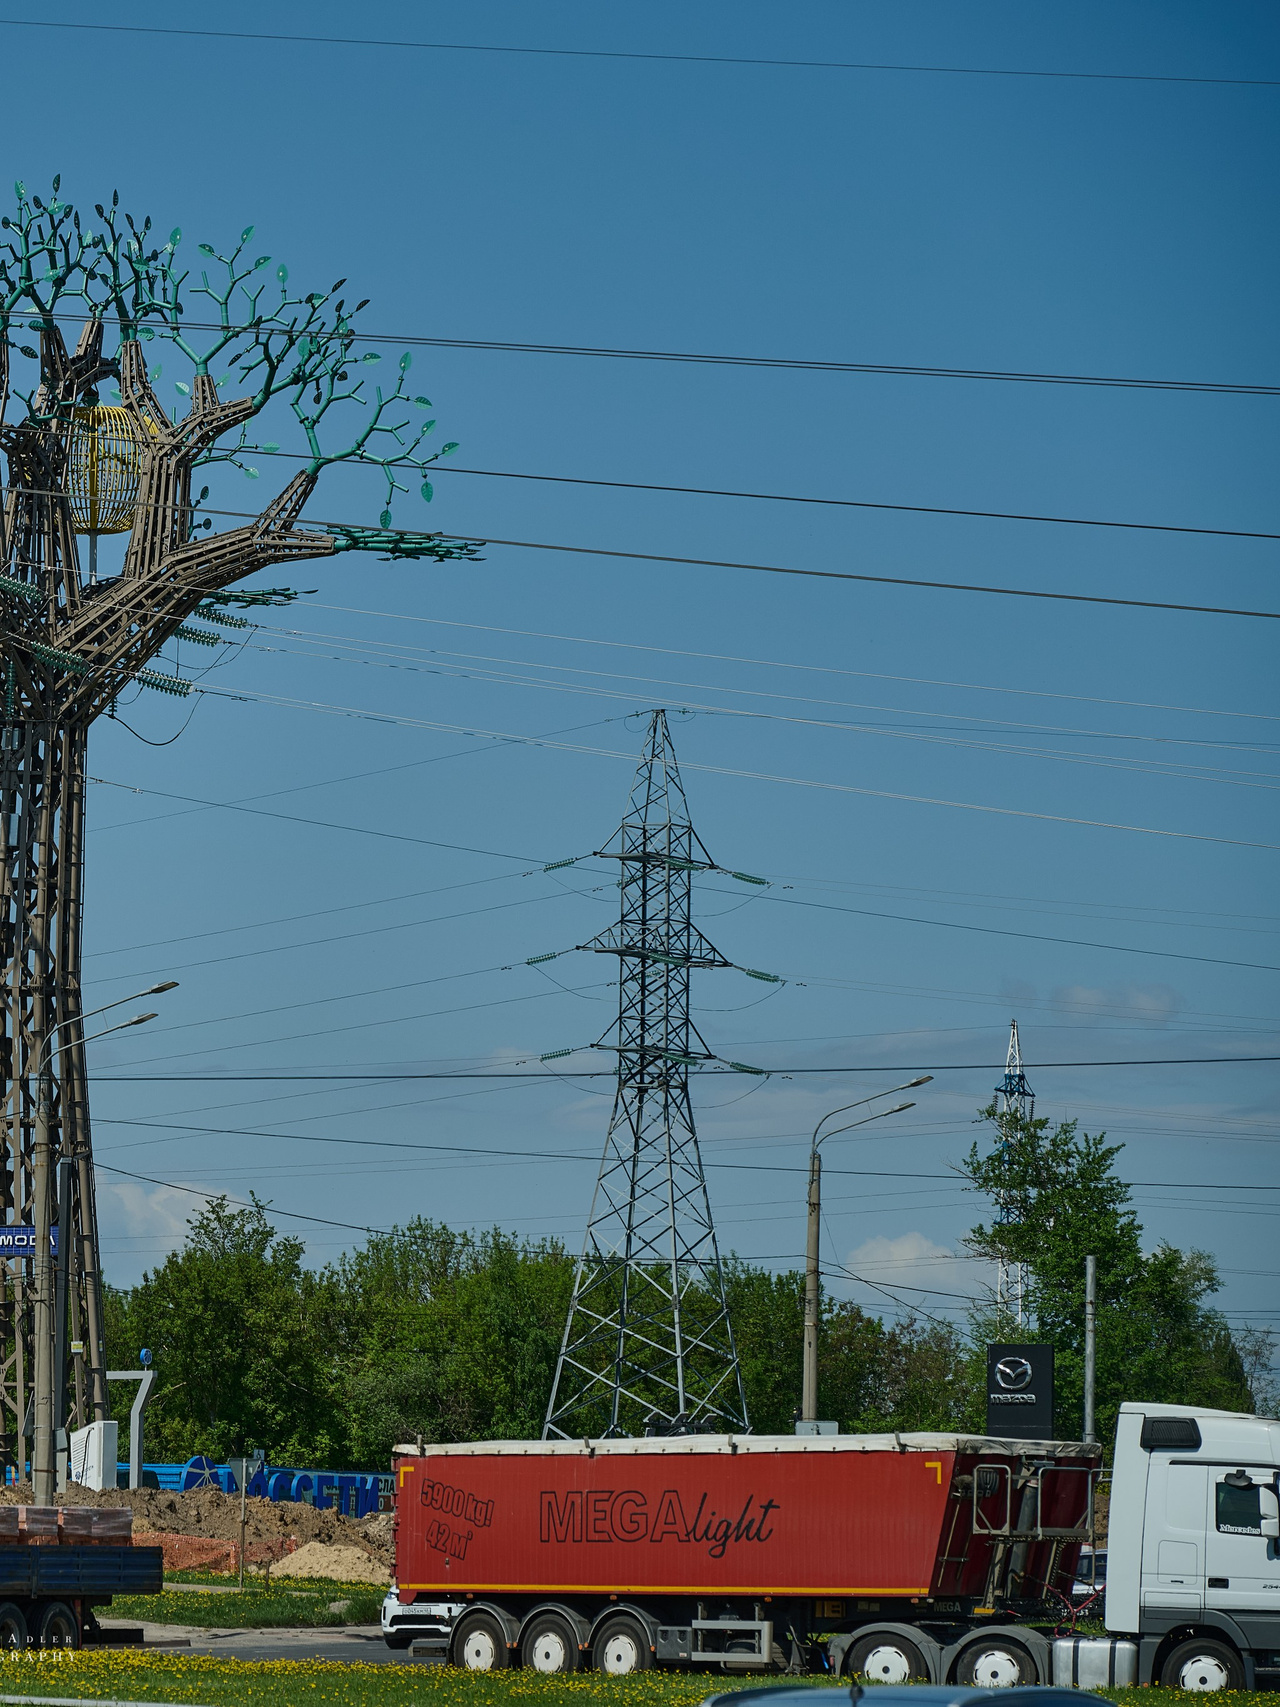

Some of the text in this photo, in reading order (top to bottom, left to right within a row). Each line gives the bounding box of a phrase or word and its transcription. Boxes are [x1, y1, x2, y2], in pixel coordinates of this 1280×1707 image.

[420, 1478, 495, 1528] 5900 kg!
[426, 1519, 451, 1553] 42
[1220, 1524, 1261, 1535] Mercedes
[933, 1601, 962, 1612] MEGA
